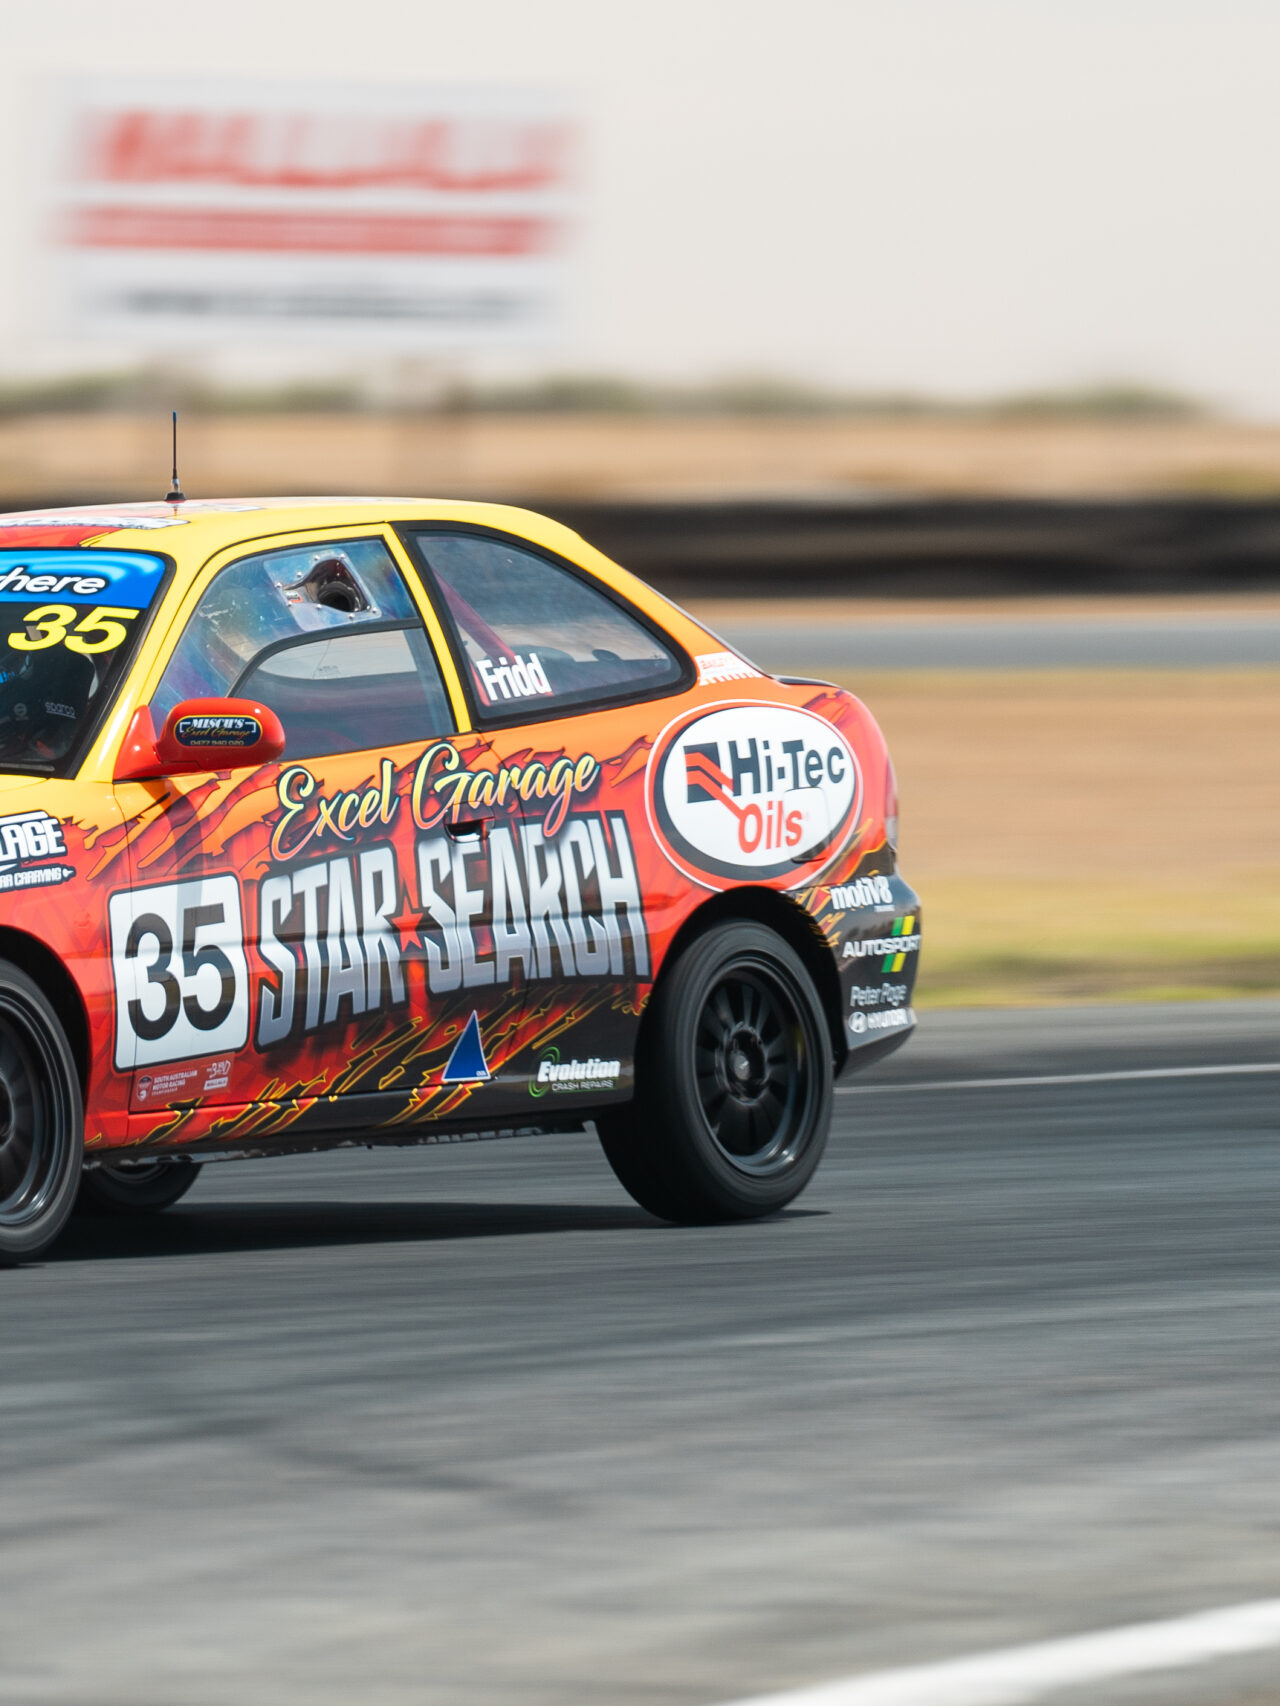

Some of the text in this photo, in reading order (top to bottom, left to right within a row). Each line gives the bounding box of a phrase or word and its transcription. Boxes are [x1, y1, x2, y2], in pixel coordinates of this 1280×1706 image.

[7, 604, 140, 654] 35
[476, 653, 552, 700] Fridd
[182, 727, 251, 740] Excel Garage
[192, 718, 245, 729] MISCH'S
[728, 737, 845, 797] Hi-Tec
[272, 742, 600, 861] Excel Garage
[738, 800, 803, 854] Oils
[14, 867, 62, 887] CARRYING
[256, 817, 650, 1048] STAR SEARCH
[842, 934, 921, 958] AUTOSPORT
[127, 902, 236, 1042] 35
[850, 982, 907, 1007] Peter Page
[537, 1058, 621, 1082] Evolution
[552, 1080, 614, 1092] CRASH REPAIRS
